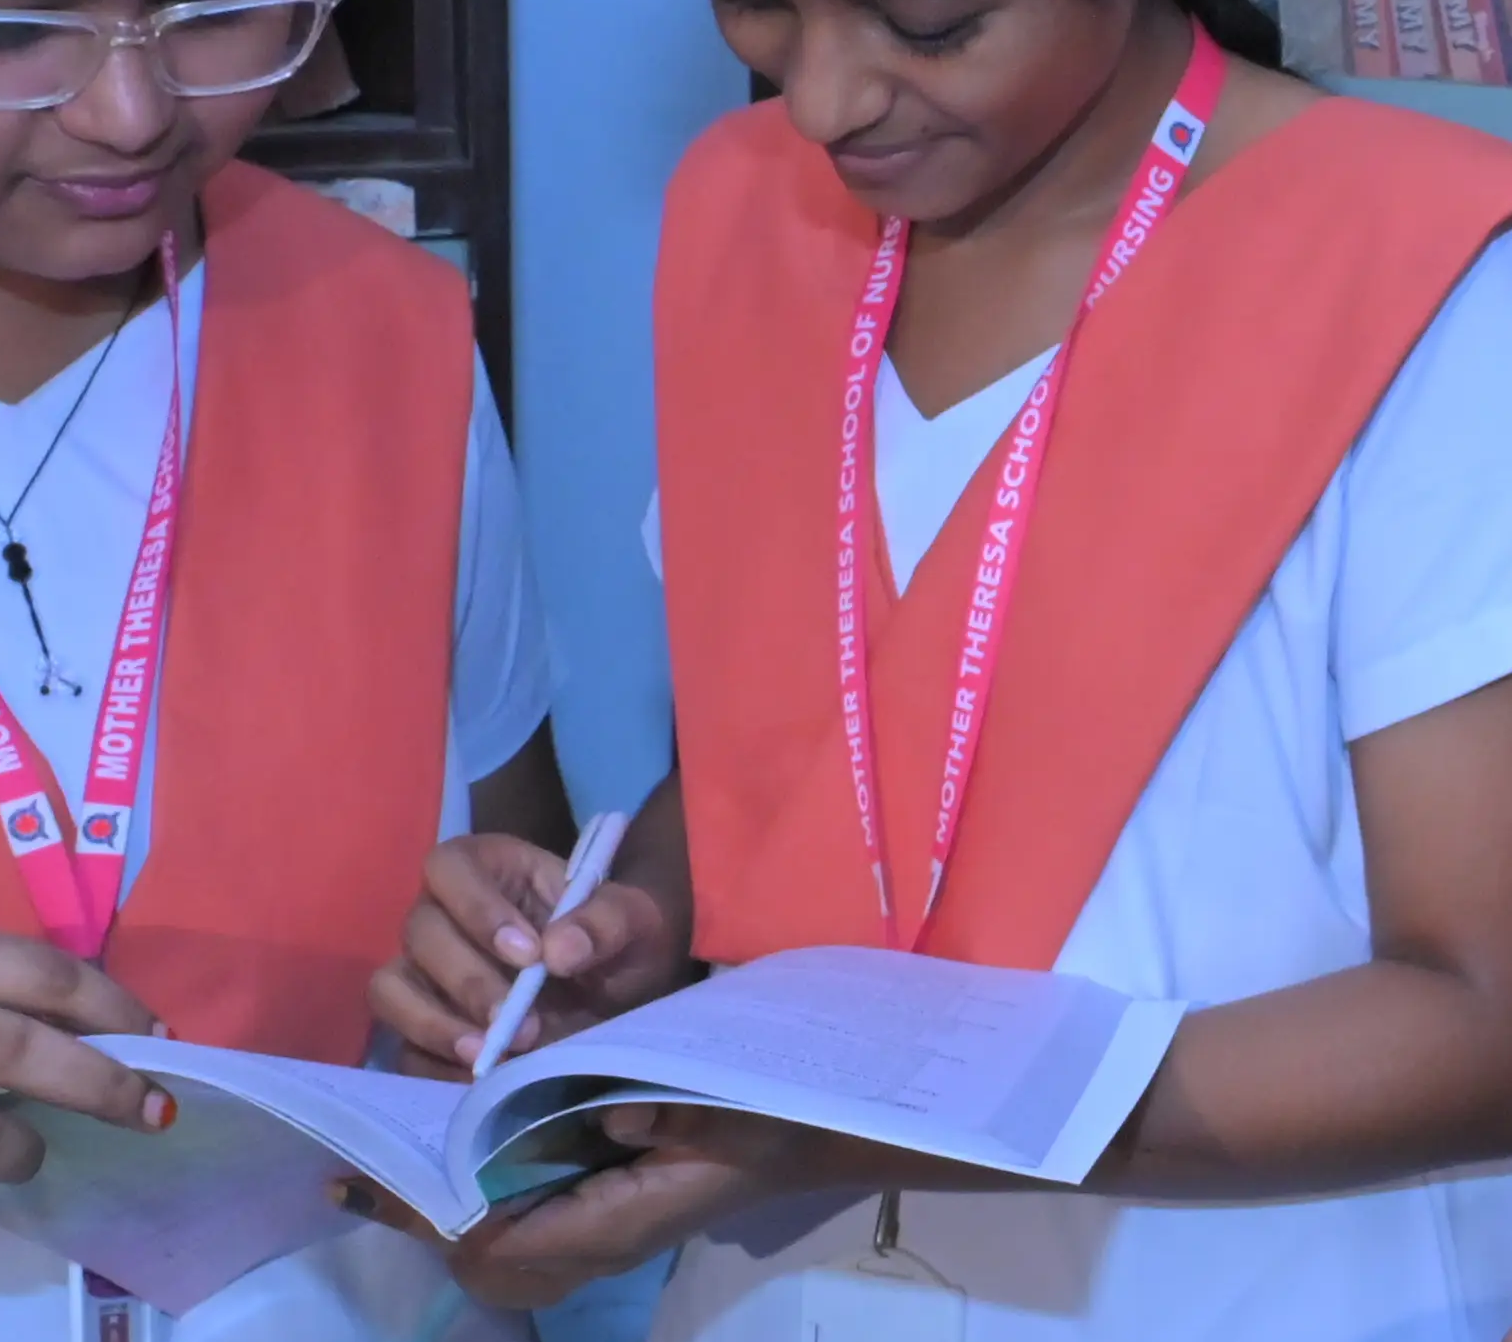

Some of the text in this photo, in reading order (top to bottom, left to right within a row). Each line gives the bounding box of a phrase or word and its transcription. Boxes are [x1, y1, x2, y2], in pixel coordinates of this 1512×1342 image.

[119, 520, 171, 642] THERESA
[835, 310, 877, 848] MOTHER THERESA SCHOOL OF
[932, 165, 1175, 846] MOTHER THERESA NURSING
[93, 642, 146, 783] MOTHER
